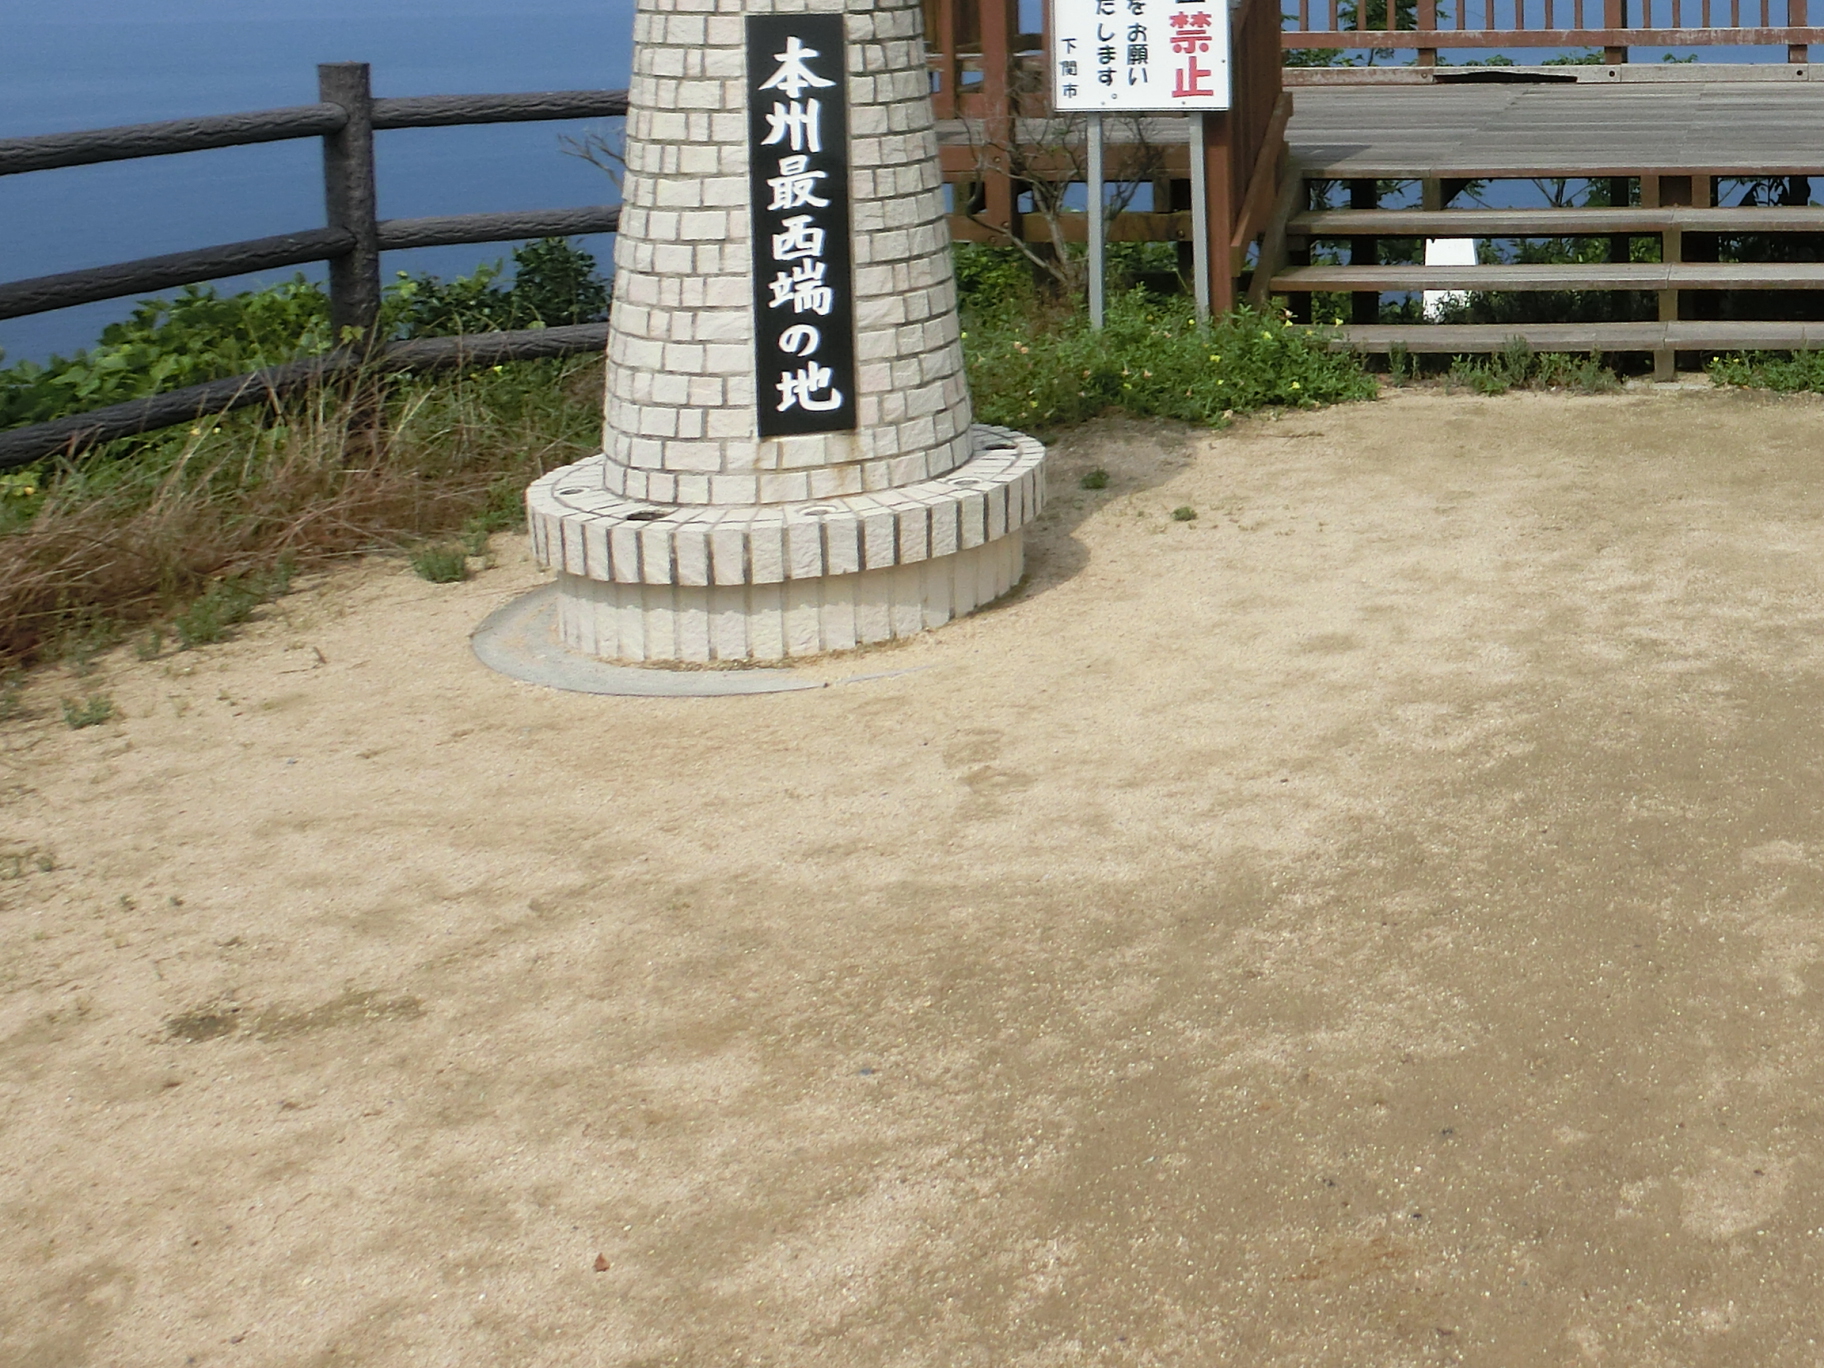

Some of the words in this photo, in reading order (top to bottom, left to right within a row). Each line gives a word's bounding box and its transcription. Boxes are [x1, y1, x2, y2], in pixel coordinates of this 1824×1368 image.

[1060, 38, 1079, 99] 下関市
[758, 36, 843, 412] 本州最西端の地
